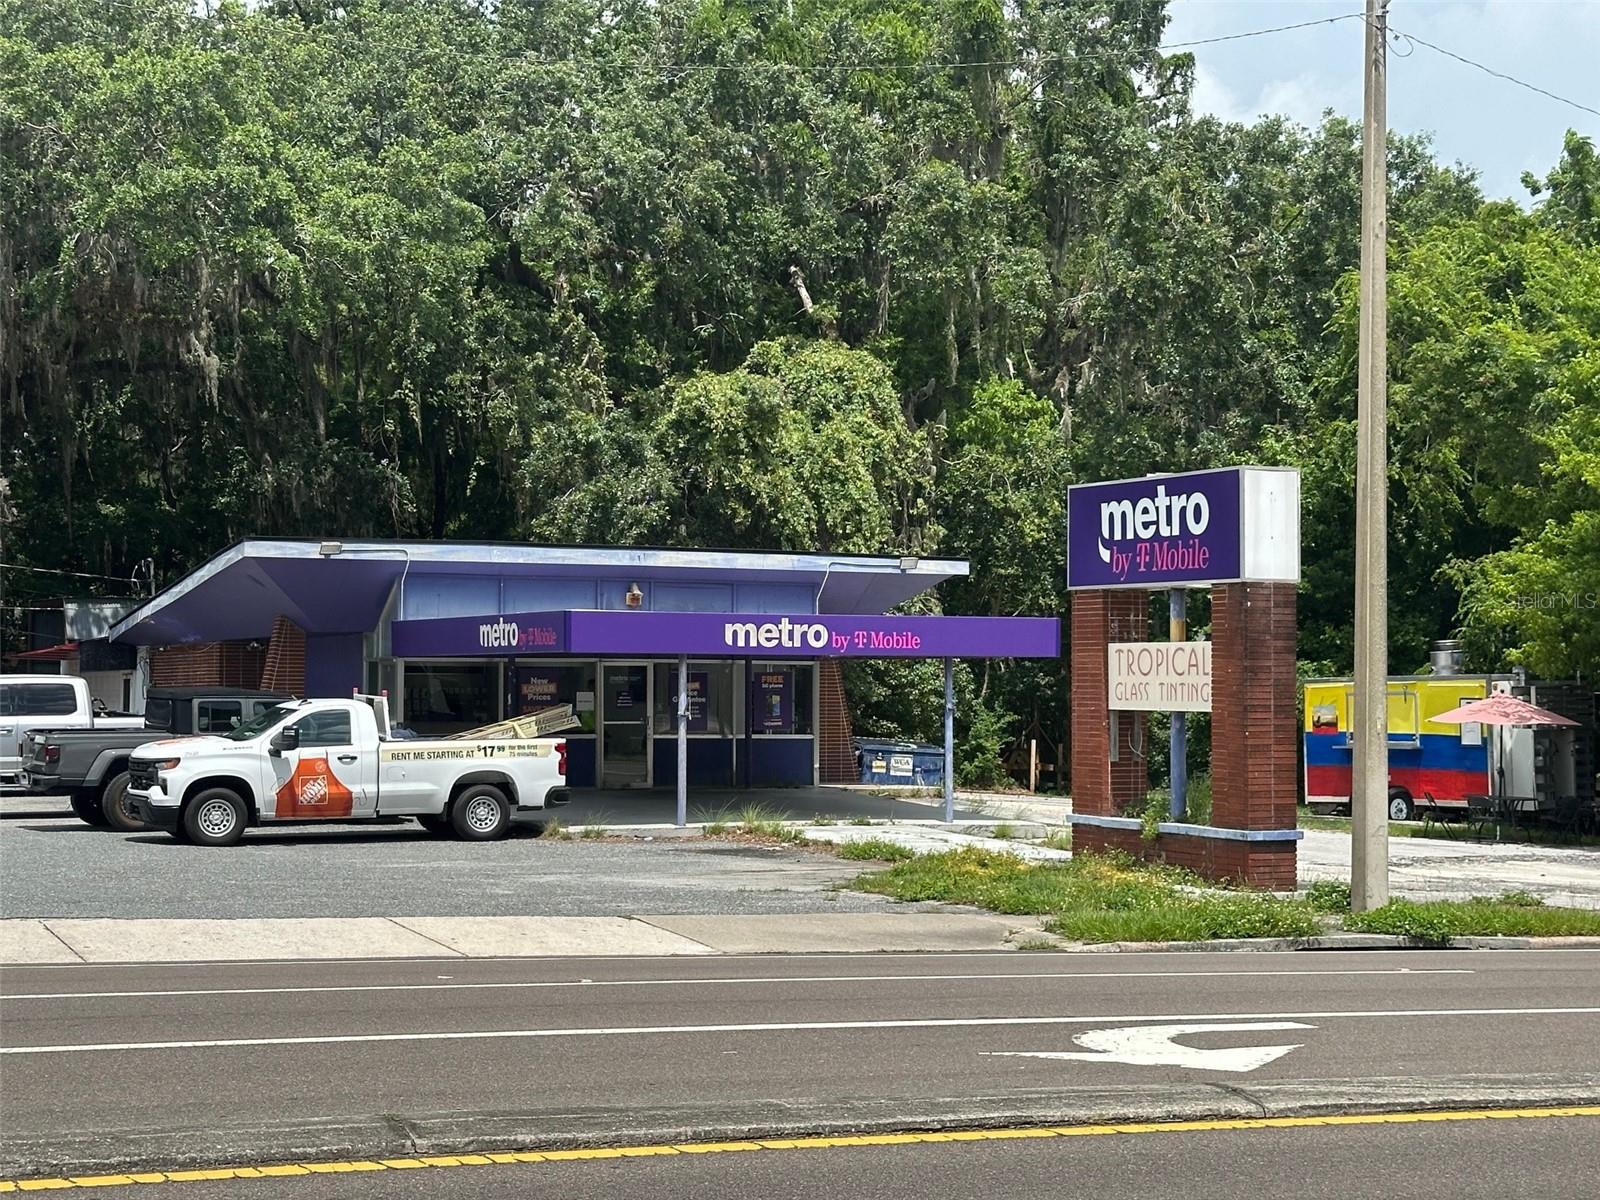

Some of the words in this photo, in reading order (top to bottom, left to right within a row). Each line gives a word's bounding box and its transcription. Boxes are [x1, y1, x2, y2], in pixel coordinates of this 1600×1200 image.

[1099, 485, 1210, 542] metro
[1112, 546, 1133, 581] by
[479, 616, 519, 648] metro
[518, 629, 528, 651] by
[724, 617, 829, 648] metro
[831, 631, 851, 652] by
[1115, 646, 1210, 677] TROPICAL
[530, 677, 549, 685] New
[761, 675, 785, 684] FREE
[1115, 682, 1150, 701] GLASS
[1158, 682, 1210, 703] TINTING
[527, 693, 552, 701] Prices
[391, 752, 411, 760] RENT
[413, 751, 425, 760] ME
[426, 750, 464, 760] STARTING
[465, 750, 475, 758] AT
